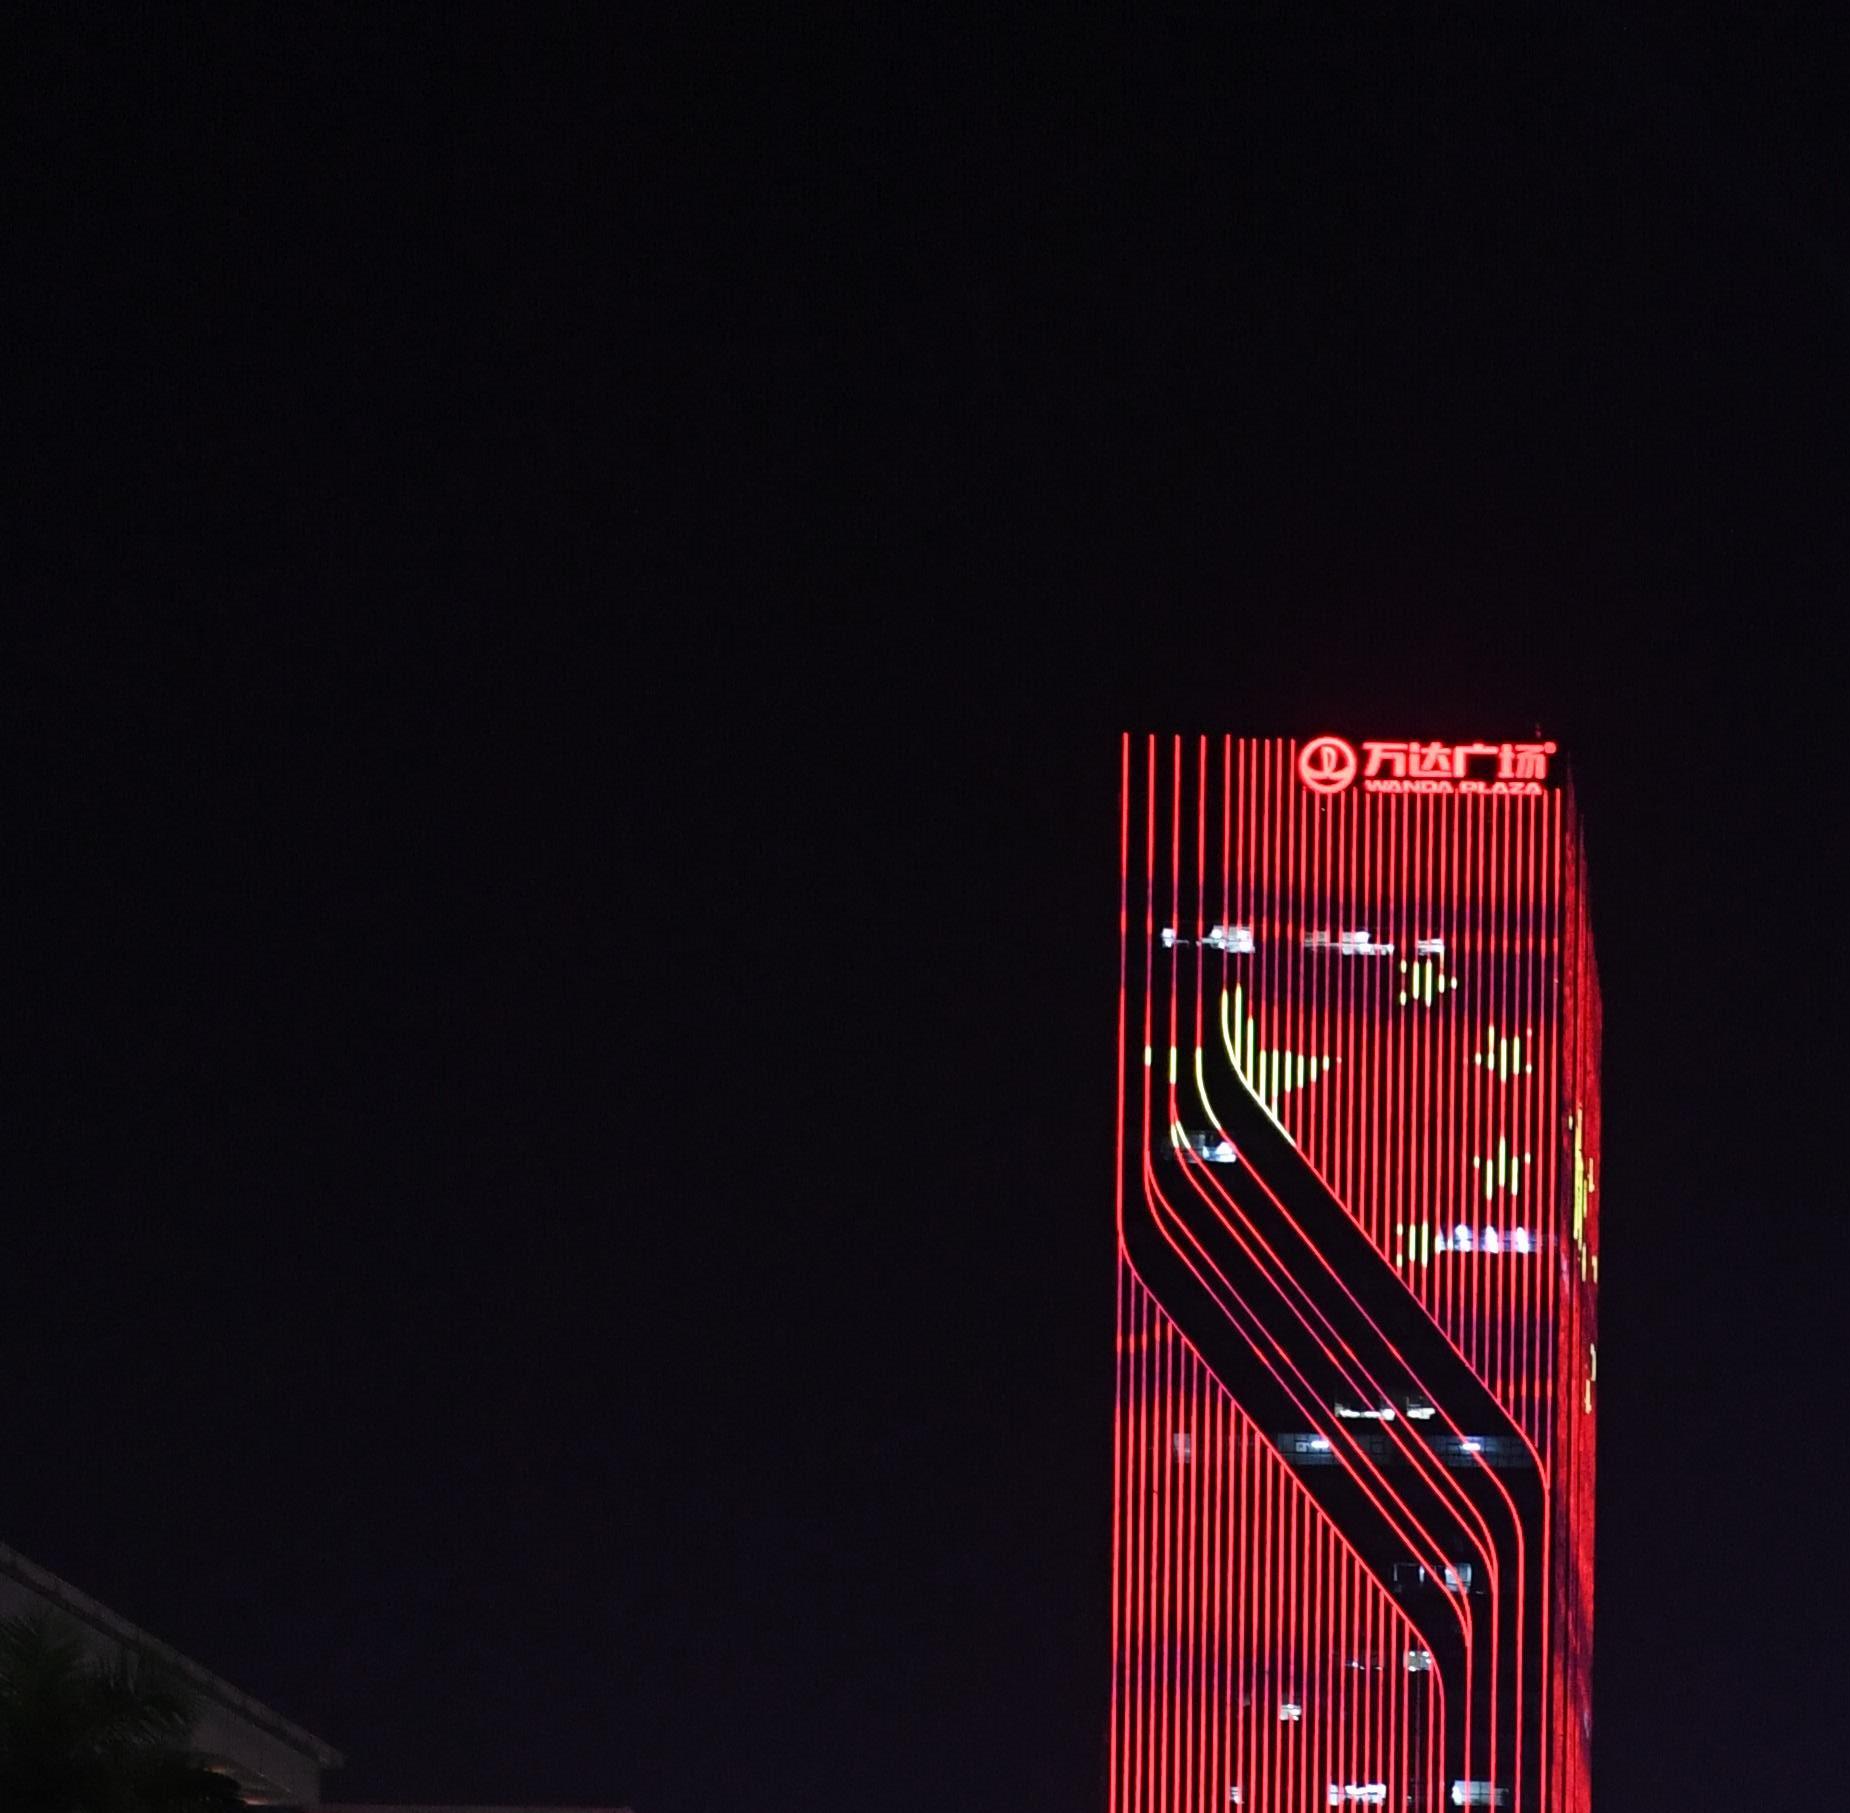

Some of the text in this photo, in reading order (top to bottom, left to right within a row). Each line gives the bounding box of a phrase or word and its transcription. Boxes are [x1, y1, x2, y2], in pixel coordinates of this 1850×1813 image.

[1362, 741, 1548, 780] 万达广场
[1364, 779, 1543, 795] WANDA PLAZA
